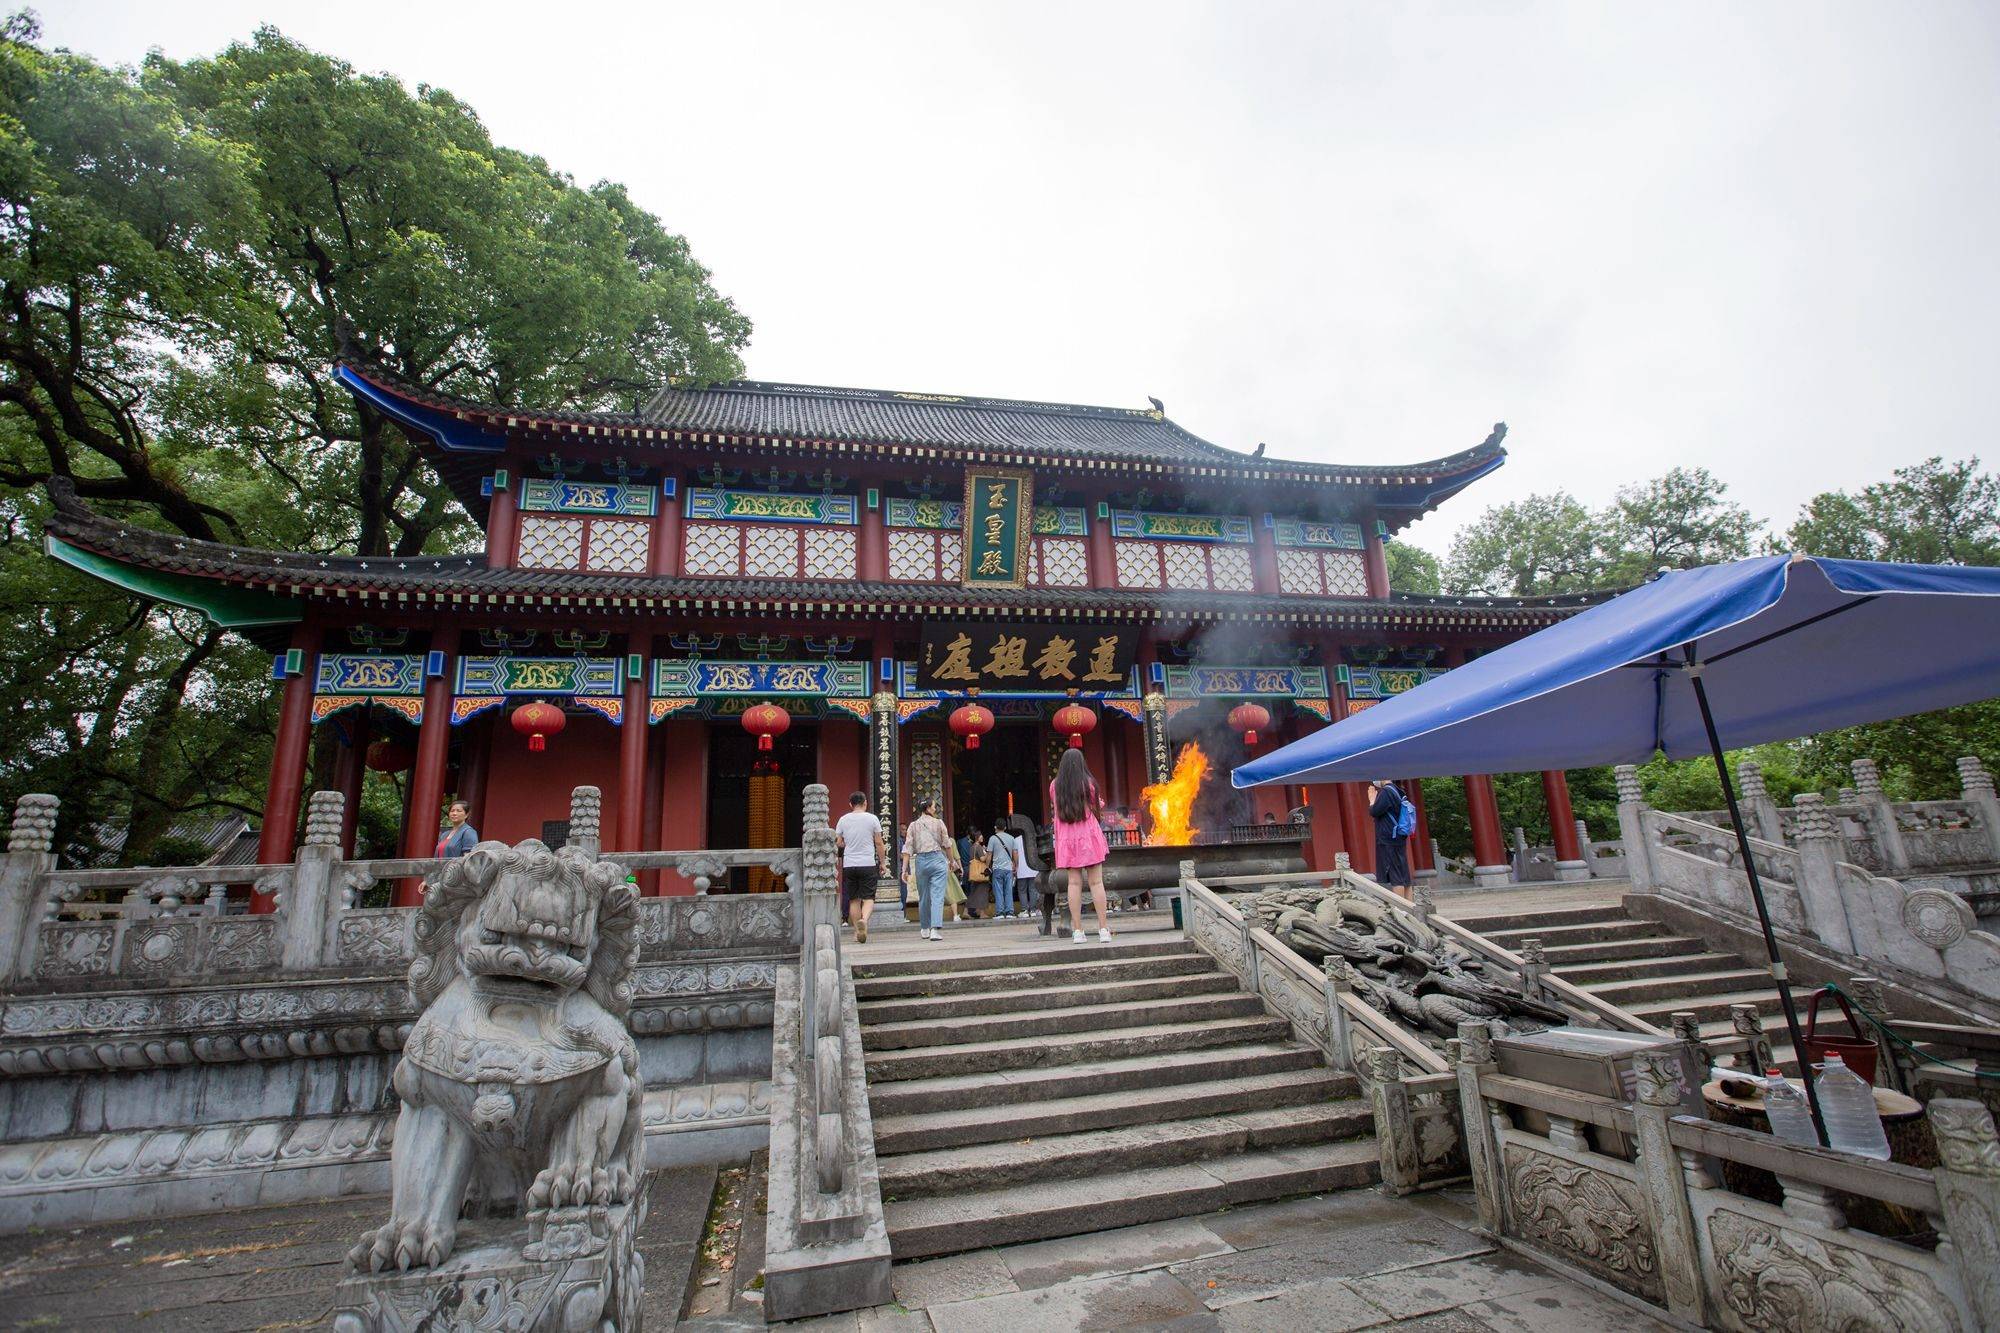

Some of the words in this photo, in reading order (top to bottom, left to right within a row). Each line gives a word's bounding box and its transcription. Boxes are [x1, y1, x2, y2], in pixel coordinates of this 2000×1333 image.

[976, 483, 1009, 576] 玉皇殿
[931, 632, 1123, 682] 道教祖庭
